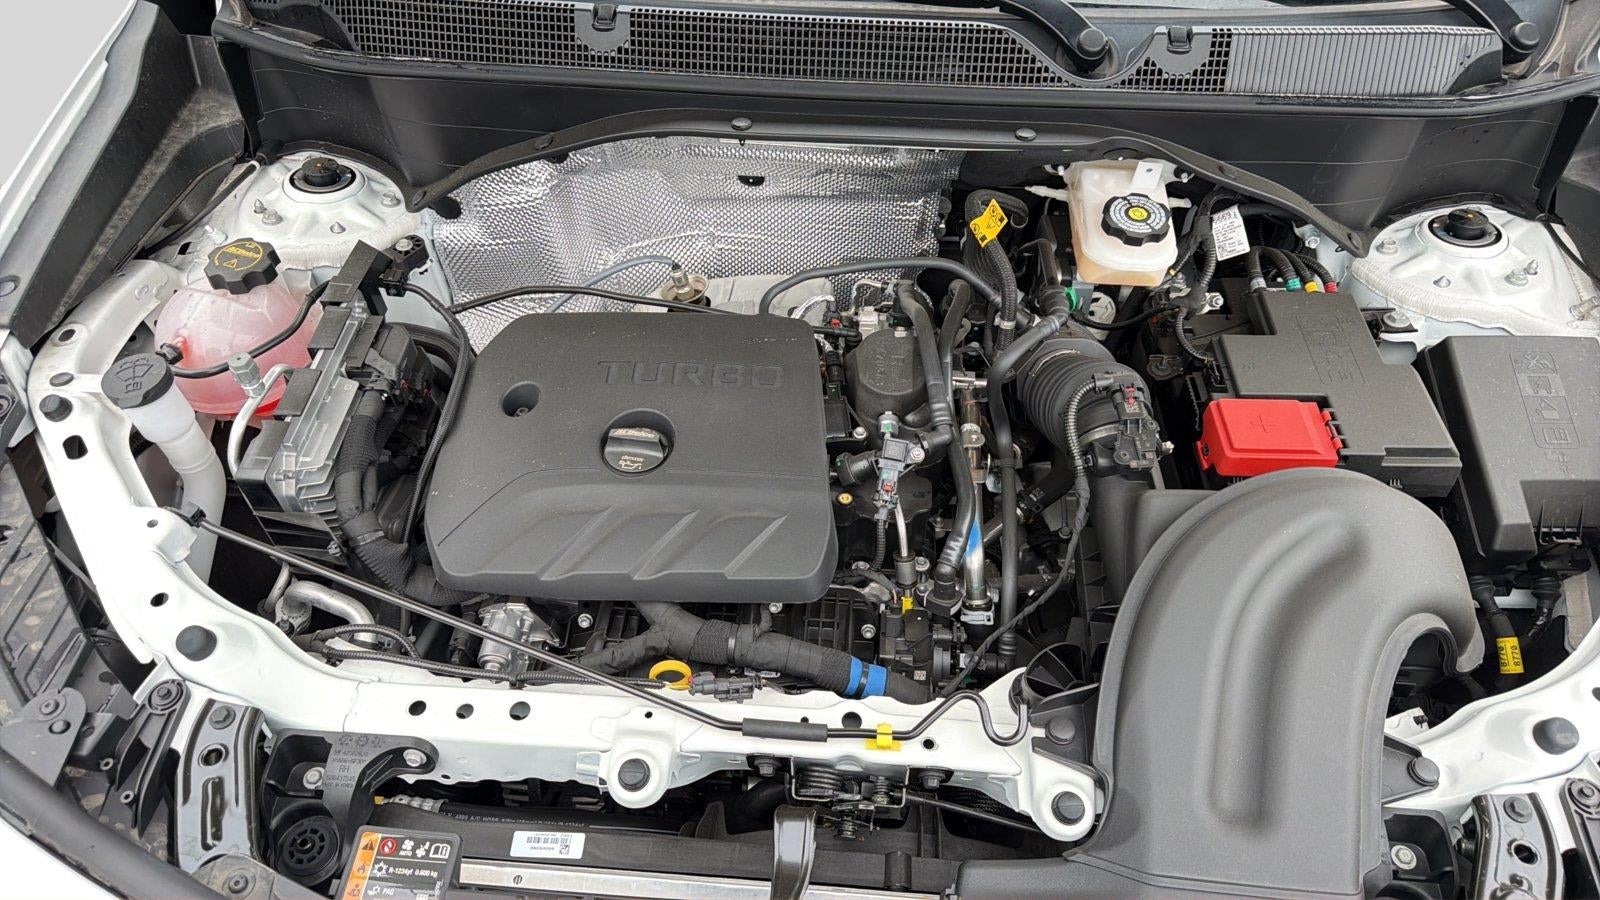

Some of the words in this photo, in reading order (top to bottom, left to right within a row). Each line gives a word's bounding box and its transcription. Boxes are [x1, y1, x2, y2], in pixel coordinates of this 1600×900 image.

[598, 361, 784, 388] TURBO
[1511, 645, 1521, 667] 8770
[338, 764, 350, 773] RH
[388, 867, 413, 876] R-1234yf
